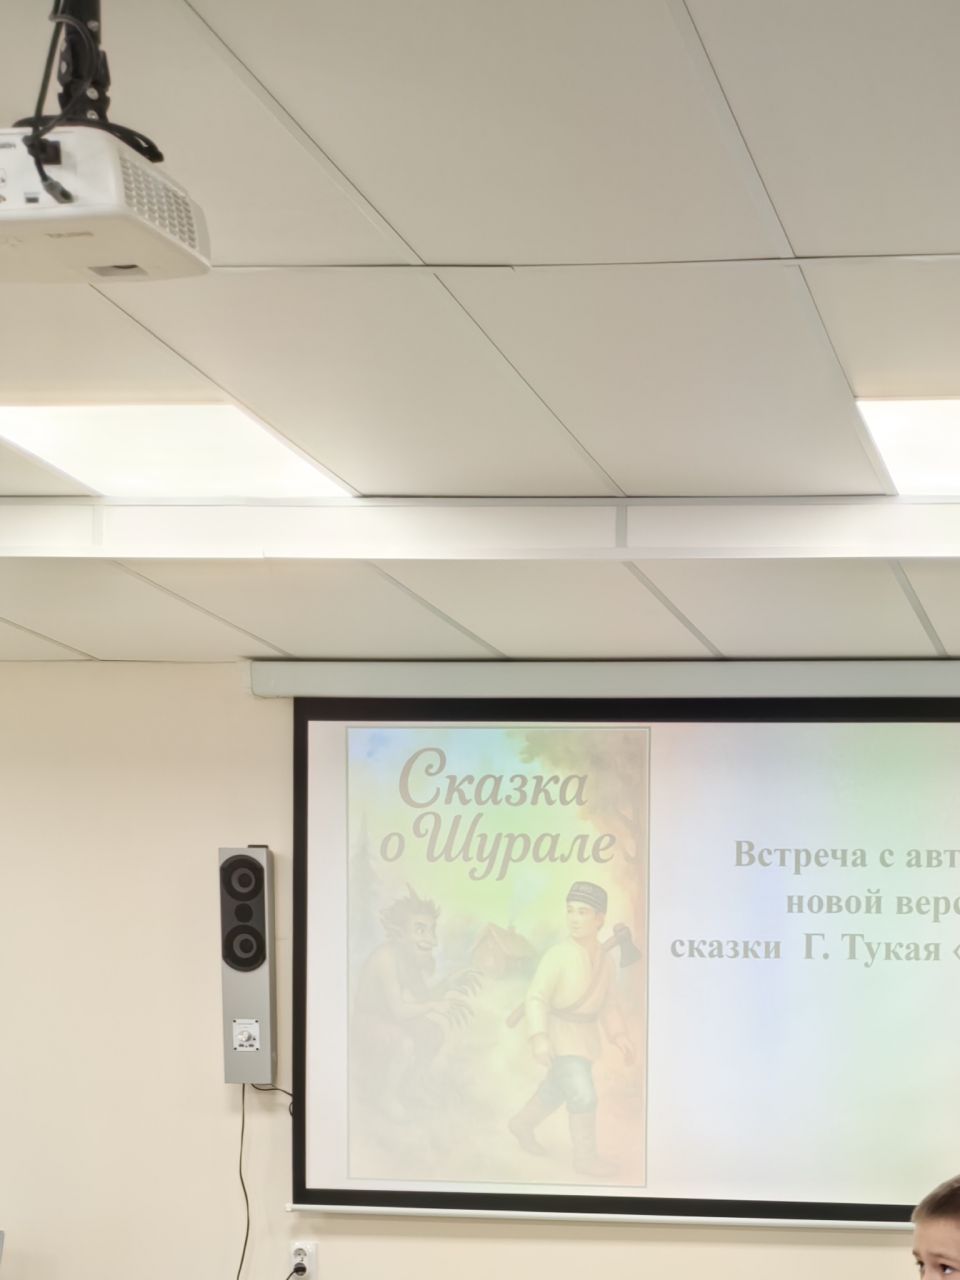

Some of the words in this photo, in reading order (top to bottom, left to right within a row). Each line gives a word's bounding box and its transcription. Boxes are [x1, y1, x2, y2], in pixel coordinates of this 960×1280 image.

[399, 747, 589, 809] Сказка
[380, 832, 405, 862] о
[412, 811, 617, 881] Шурале
[735, 840, 868, 875] Встреча
[879, 849, 894, 867] с
[786, 888, 883, 914] новой
[670, 939, 781, 959] сказки
[803, 933, 830, 960] Г.
[841, 933, 942, 968] Тукая
